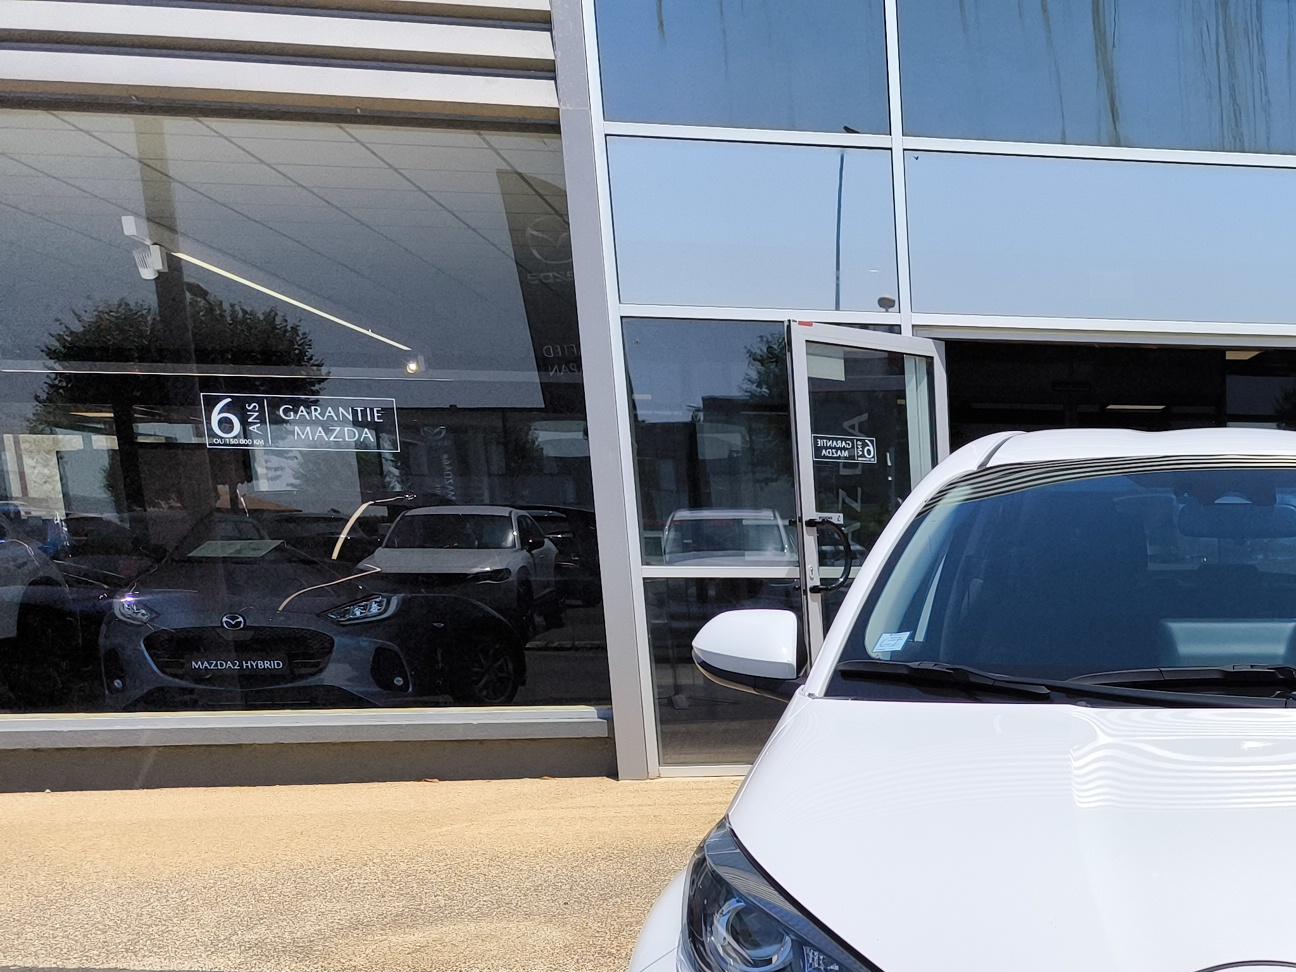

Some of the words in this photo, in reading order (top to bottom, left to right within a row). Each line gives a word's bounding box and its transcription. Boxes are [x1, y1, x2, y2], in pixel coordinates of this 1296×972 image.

[211, 398, 241, 438] 6
[246, 402, 262, 435] ANS
[279, 405, 384, 422] GARANTIE
[294, 427, 375, 442] MAZDA
[191, 660, 240, 669] MAZDA2
[243, 660, 283, 669] HYBRID
